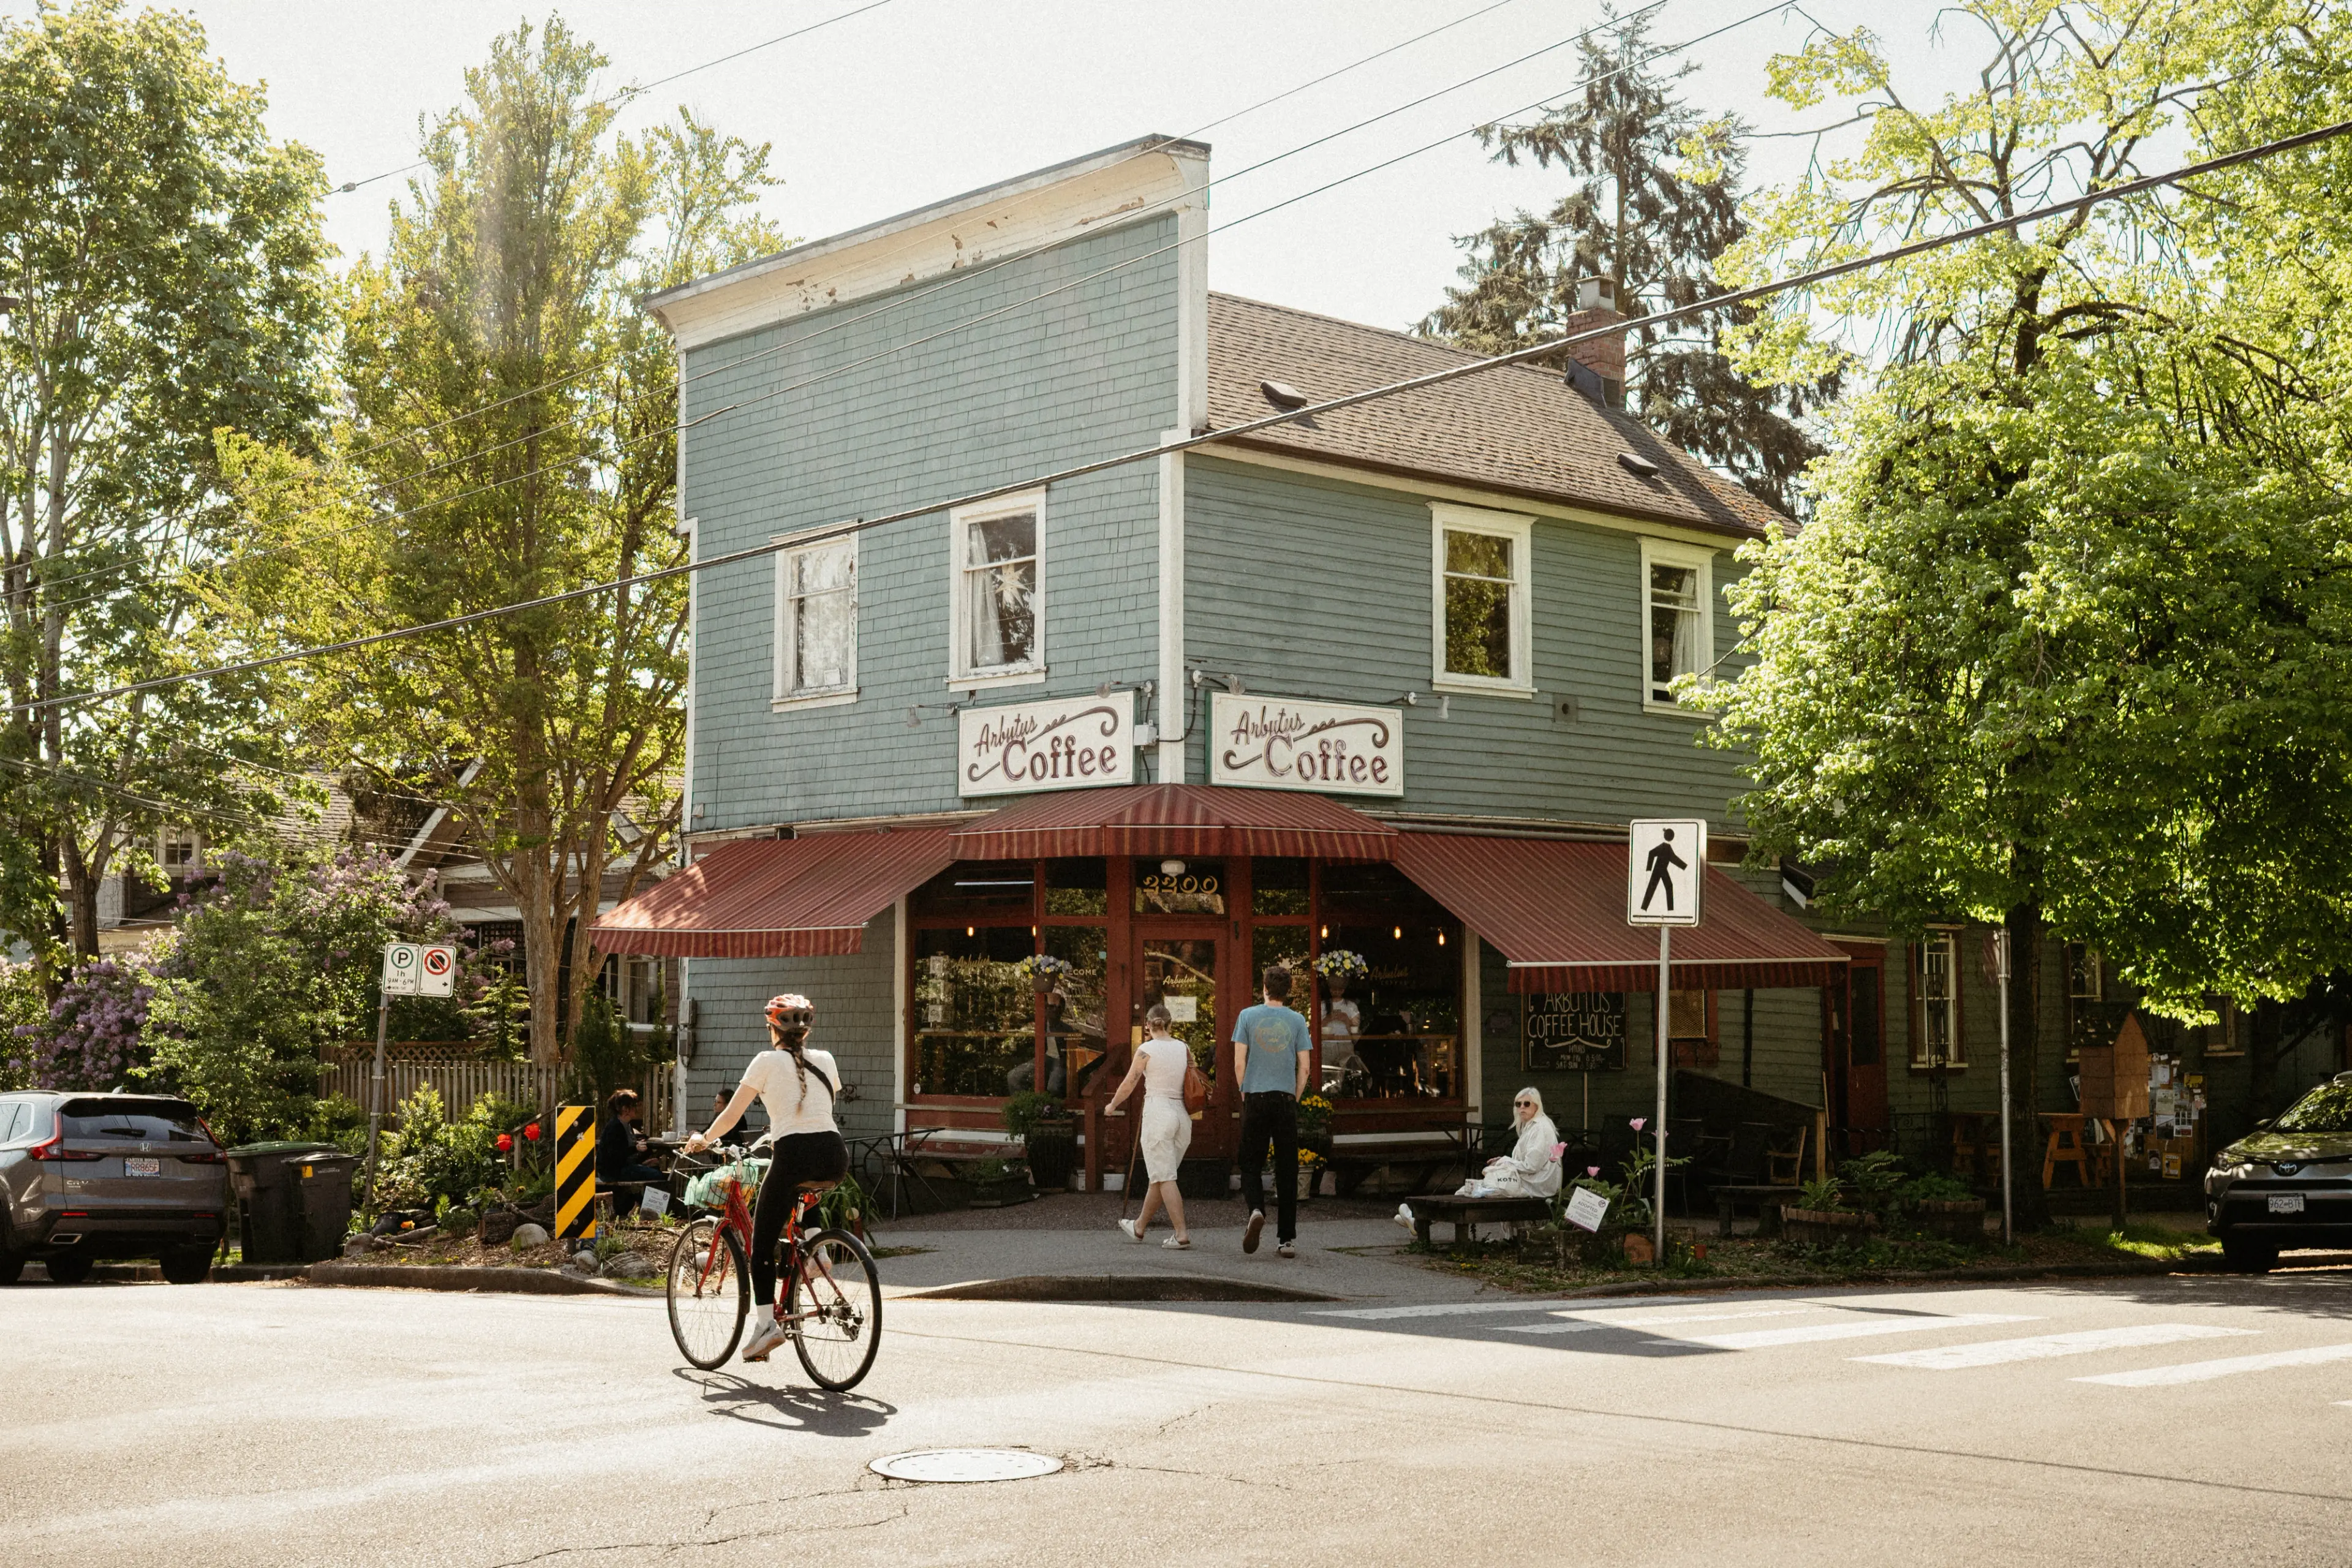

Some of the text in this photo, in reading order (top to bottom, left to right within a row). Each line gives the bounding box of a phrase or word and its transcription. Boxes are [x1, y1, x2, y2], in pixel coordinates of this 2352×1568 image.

[974, 714, 1038, 756] Arbutus
[1231, 706, 1305, 745] Arbutus
[1001, 735, 1118, 782] Coffee
[1264, 734, 1390, 785] Coffee
[1143, 875, 1218, 894] 2200
[398, 952, 409, 963] P
[1163, 974, 1196, 985] Arbutus
[1528, 1013, 1623, 1038] COFFEE HOUSE
[1577, 1201, 1598, 1213] ADOPTED
